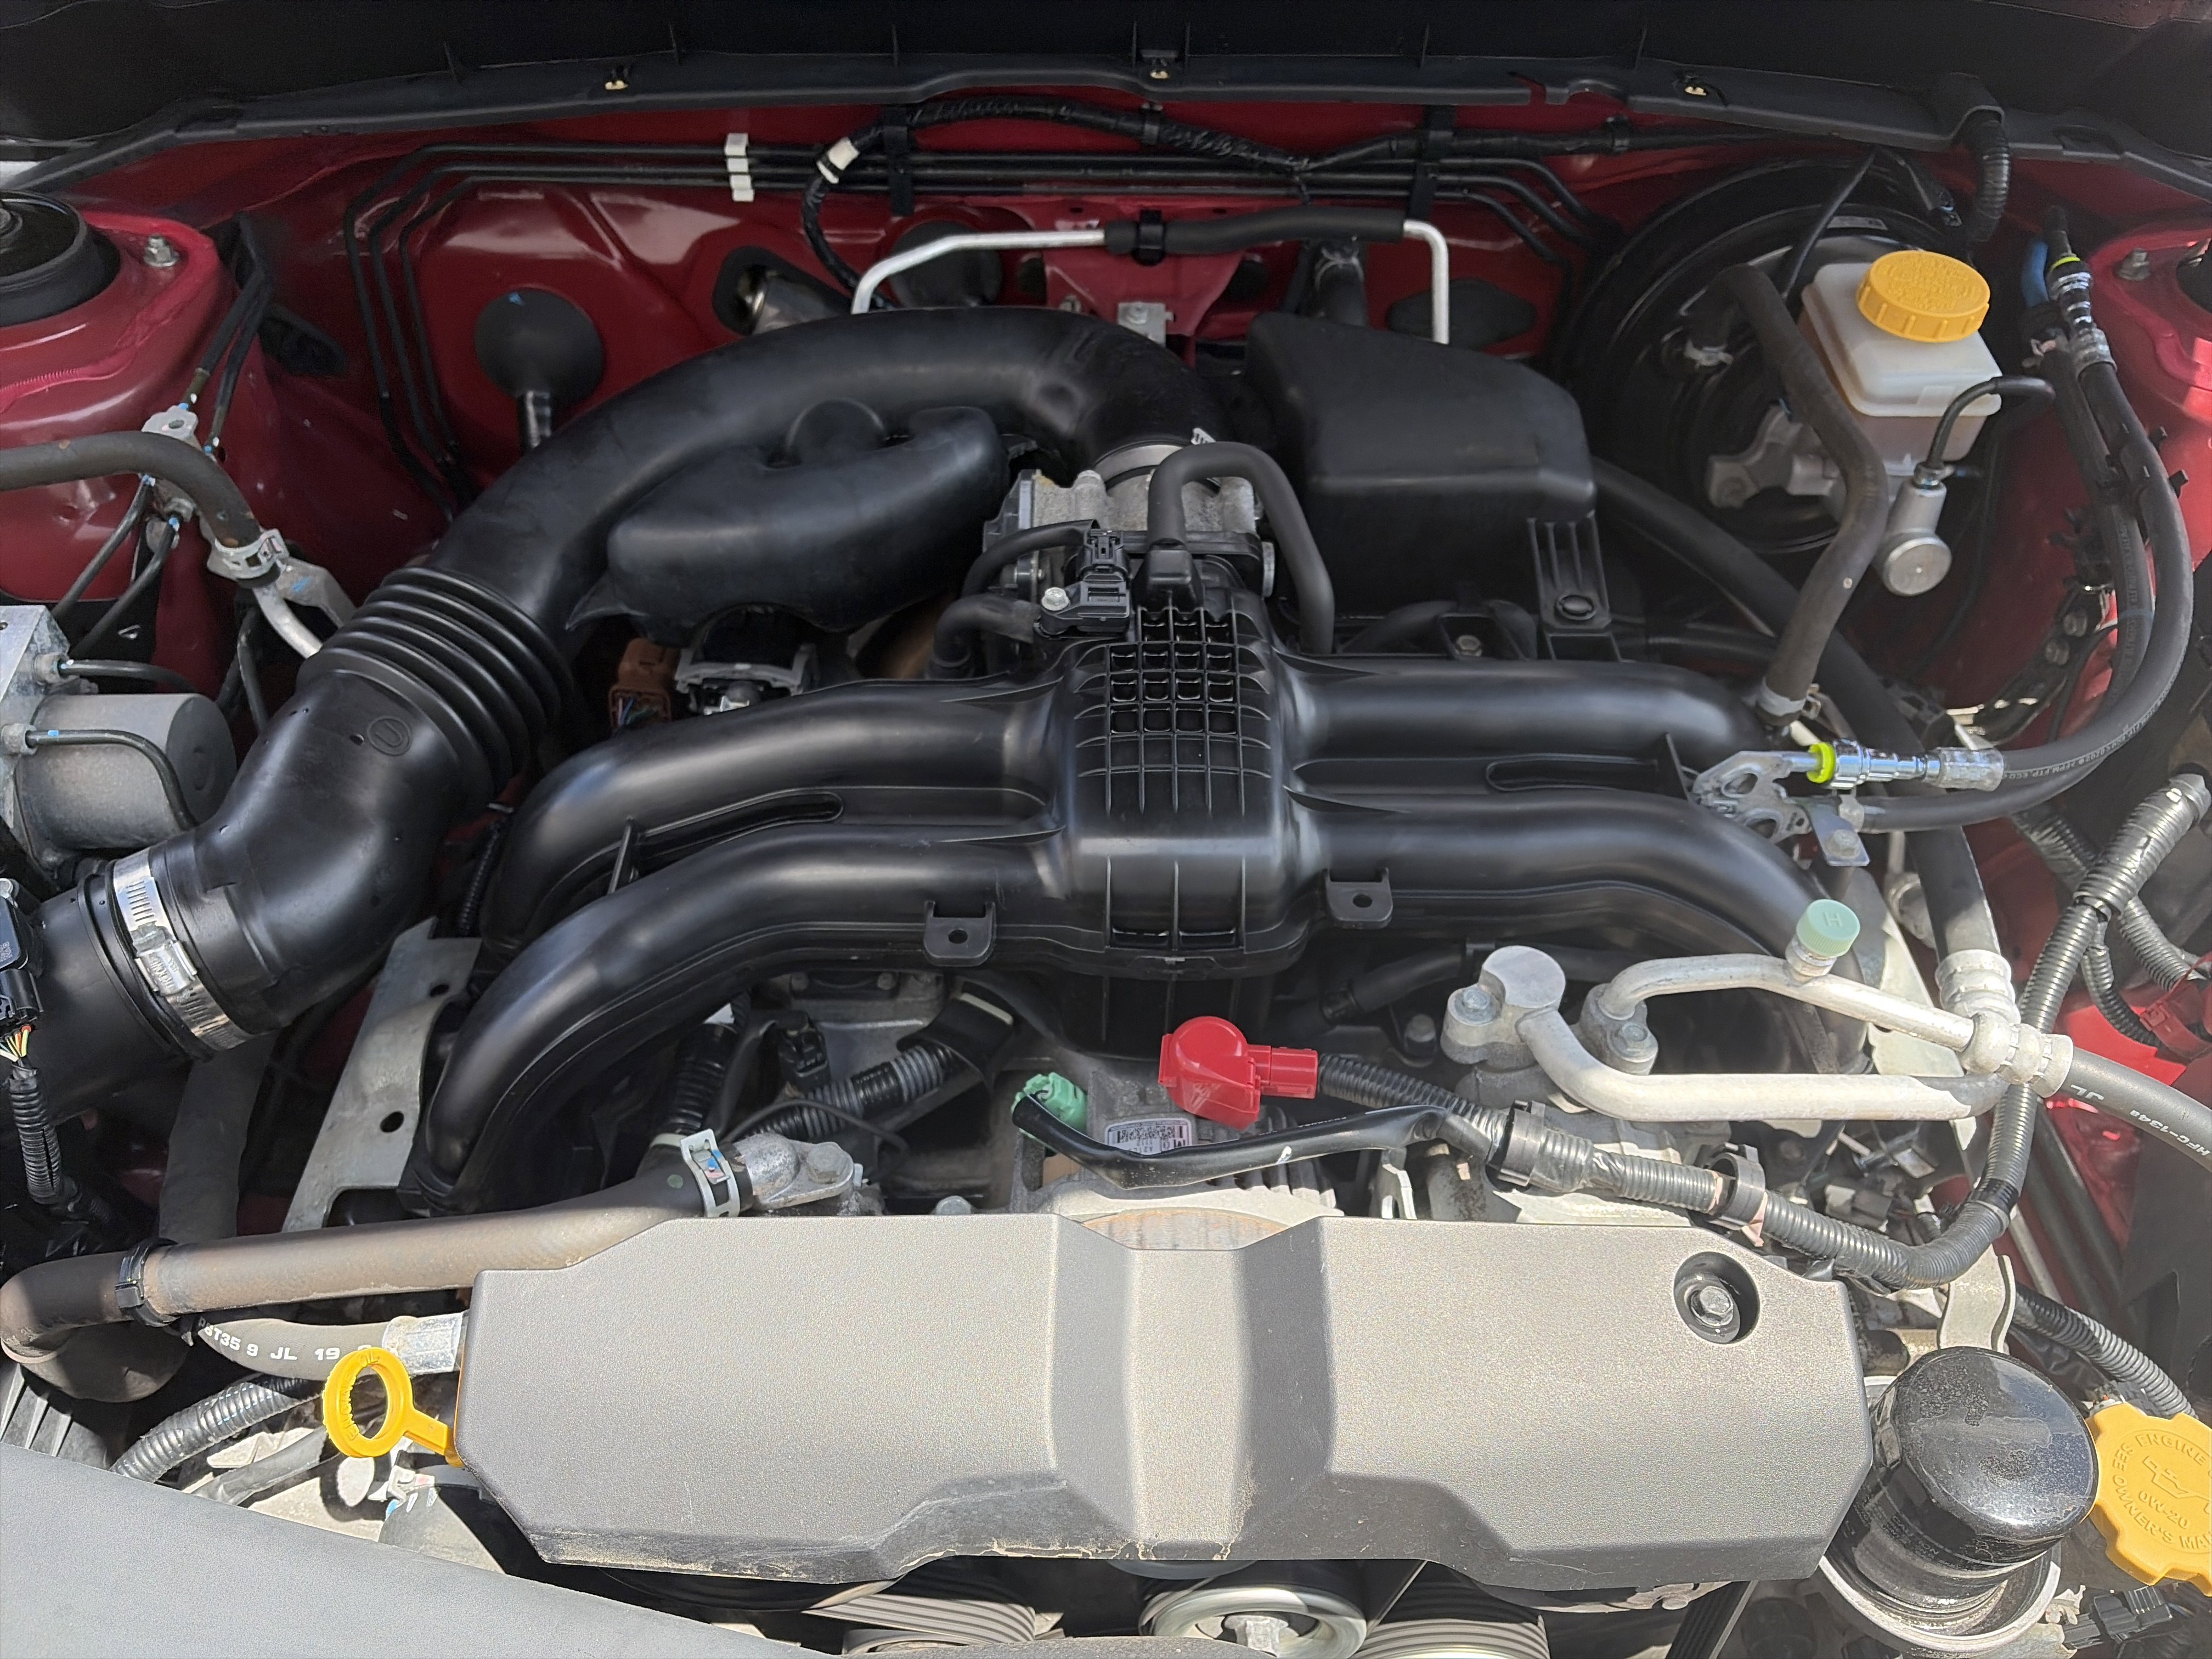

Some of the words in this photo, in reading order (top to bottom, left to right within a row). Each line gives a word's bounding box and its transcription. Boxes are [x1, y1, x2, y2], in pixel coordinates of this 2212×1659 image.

[1822, 912, 1843, 928] H
[2130, 1110, 2210, 1156] HFC-134a
[247, 1344, 258, 1357] 9
[270, 1347, 297, 1361] JL
[315, 1347, 340, 1361] 19
[358, 1350, 379, 1367] OIL
[2112, 1442, 2134, 1471] SEE
[2135, 1433, 2206, 1466] ENGINE
[2113, 1475, 2172, 1544] OWNER'S
[2138, 1490, 2190, 1530] 0W-20
